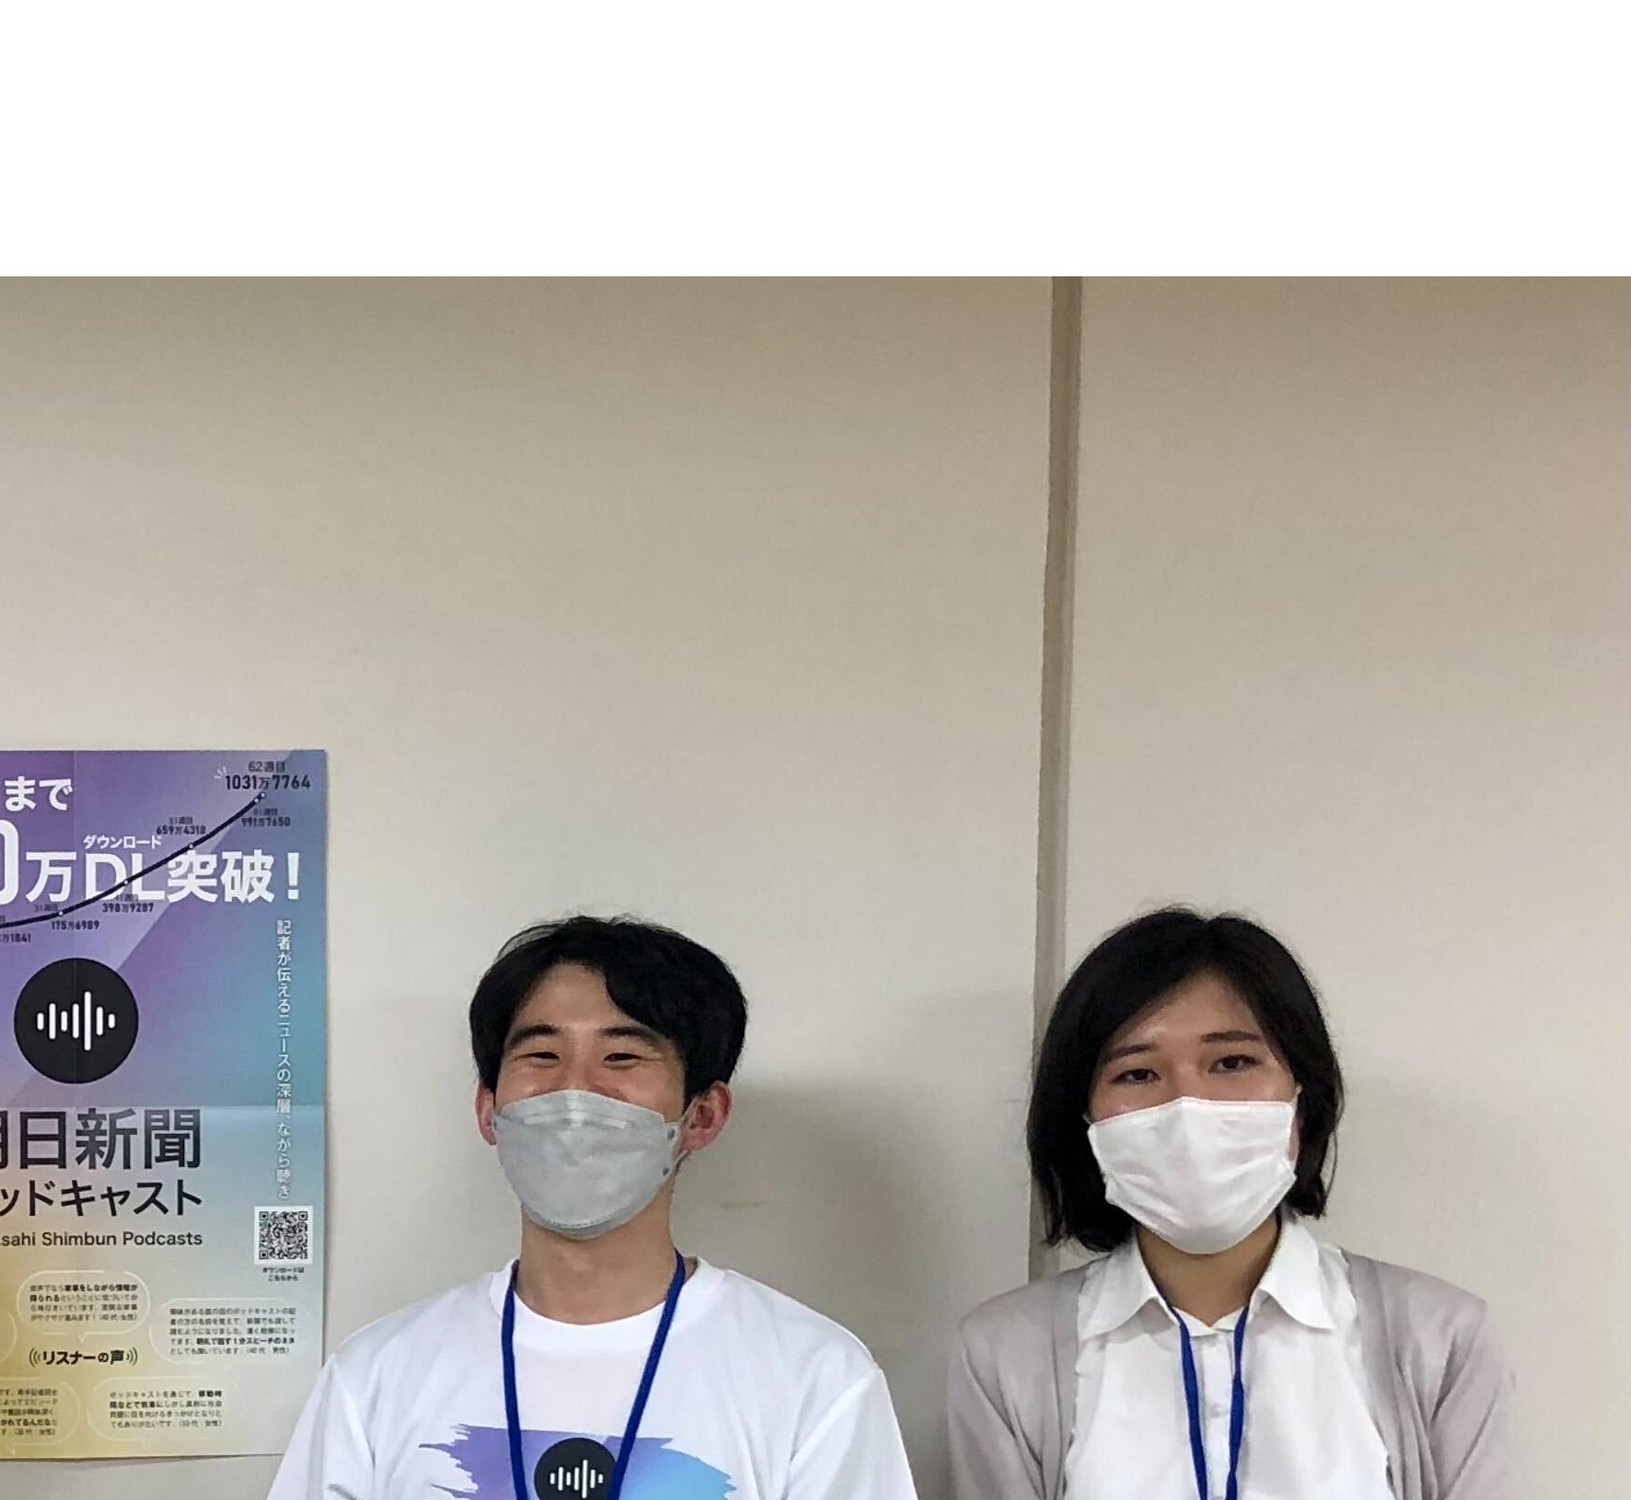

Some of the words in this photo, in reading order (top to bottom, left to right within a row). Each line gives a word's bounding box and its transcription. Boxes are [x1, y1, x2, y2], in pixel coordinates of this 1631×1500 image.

[225, 774, 311, 791] 1031万7764
[83, 835, 163, 850] ダウンロード
[102, 903, 154, 913] 398万9287
[51, 920, 100, 930] 175万6989
[41, 1231, 117, 1247] Shimbun
[122, 1231, 203, 1247] Podcasts
[42, 1349, 125, 1366] リスナーの声
